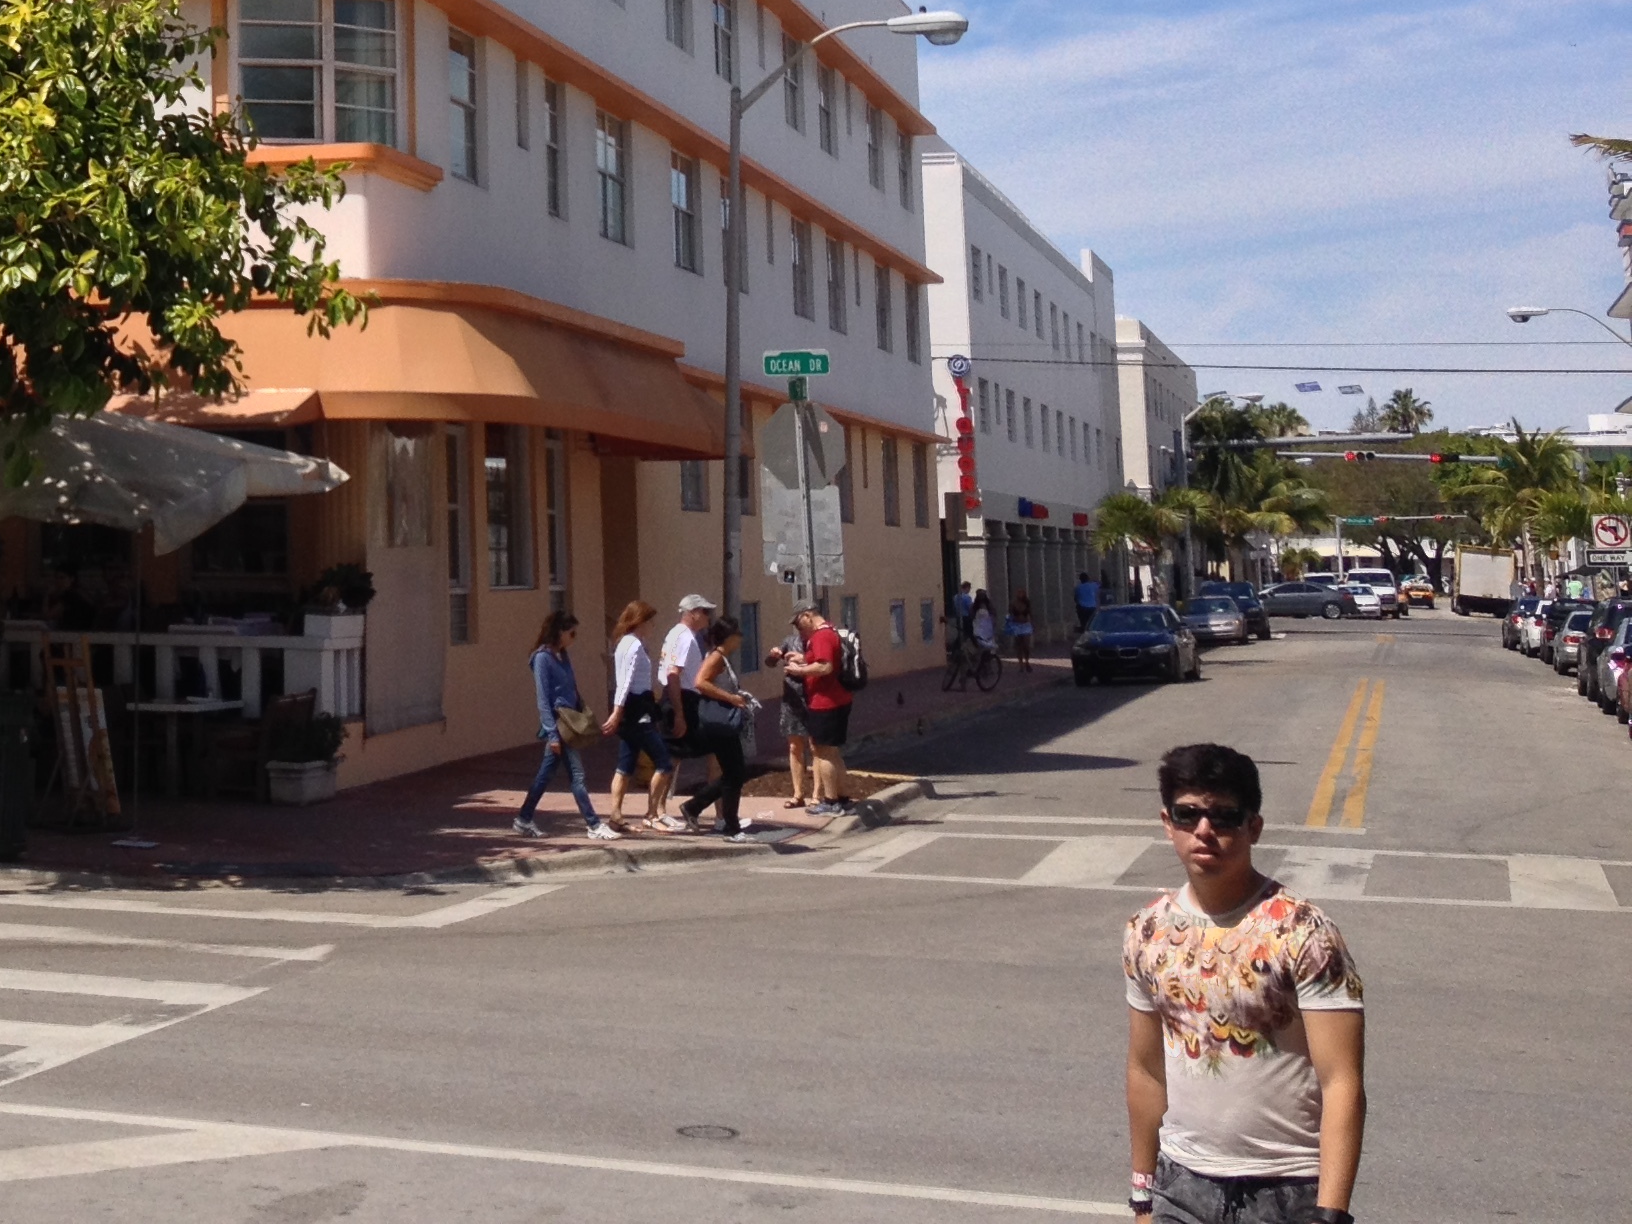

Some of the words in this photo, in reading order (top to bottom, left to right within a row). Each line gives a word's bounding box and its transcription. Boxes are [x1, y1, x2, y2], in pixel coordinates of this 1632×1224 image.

[769, 359, 801, 373] OCEAN
[808, 358, 822, 372] DR
[1591, 554, 1607, 562] ONE
[1609, 554, 1625, 562] WAY
